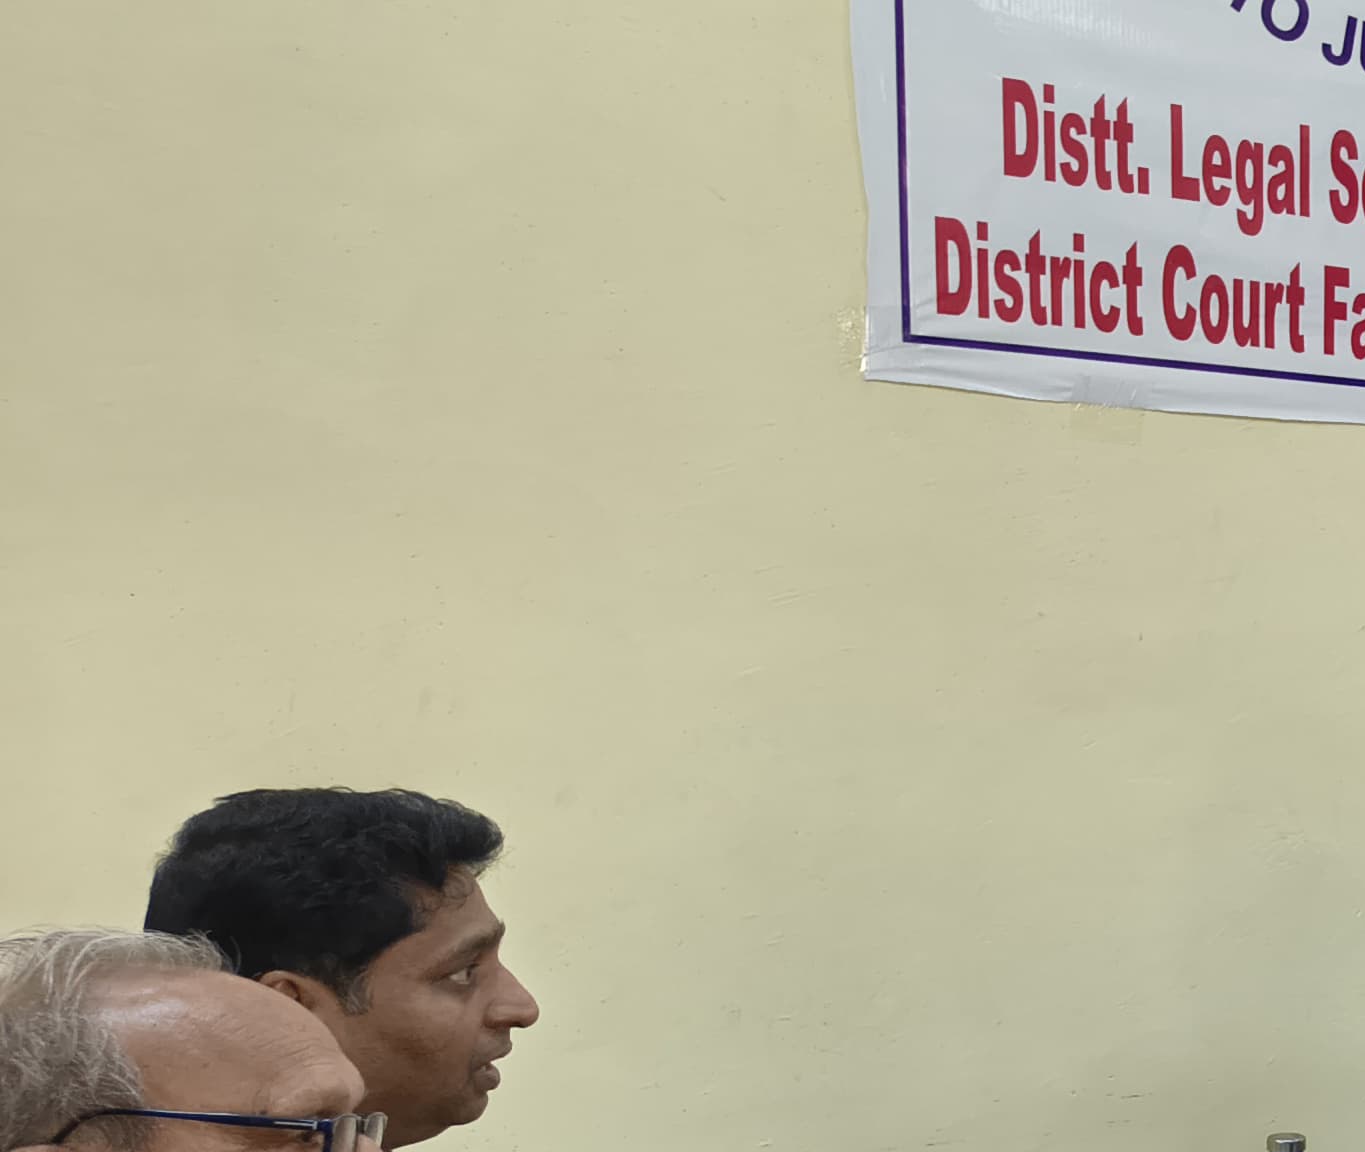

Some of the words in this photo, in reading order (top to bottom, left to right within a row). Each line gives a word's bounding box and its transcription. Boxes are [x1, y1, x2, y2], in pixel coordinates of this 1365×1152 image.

[1230, 0, 1309, 41] O
[1002, 78, 1150, 196] Distt.
[1170, 104, 1311, 236] Legal
[935, 217, 1143, 336] District
[1162, 244, 1305, 353] Court
